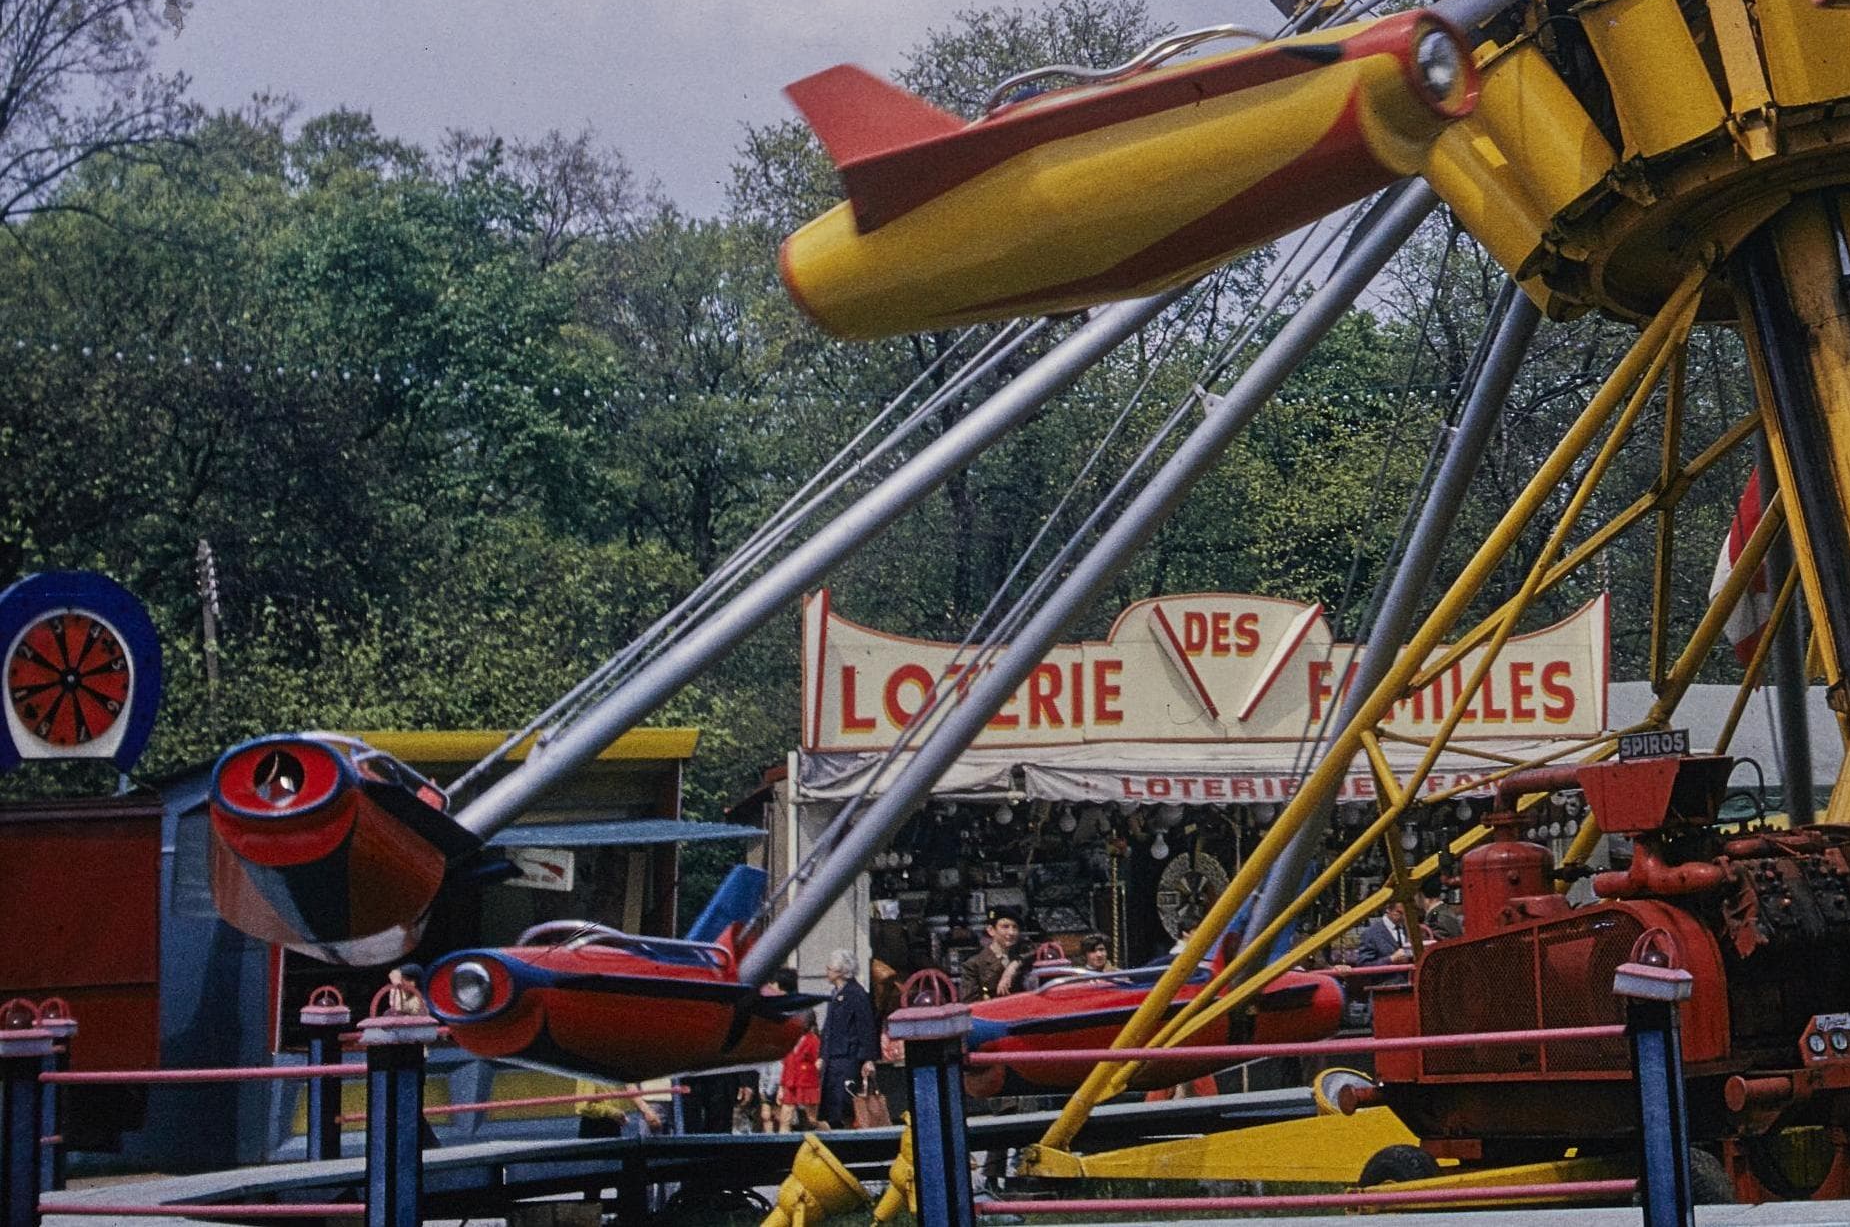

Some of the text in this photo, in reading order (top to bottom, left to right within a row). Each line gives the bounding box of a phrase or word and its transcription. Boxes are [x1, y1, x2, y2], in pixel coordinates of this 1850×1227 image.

[1184, 611, 1260, 657] DES
[1308, 660, 1575, 724] FILLES
[1621, 733, 1685, 757] SPIROS
[1121, 776, 1300, 800] LOTERIE
